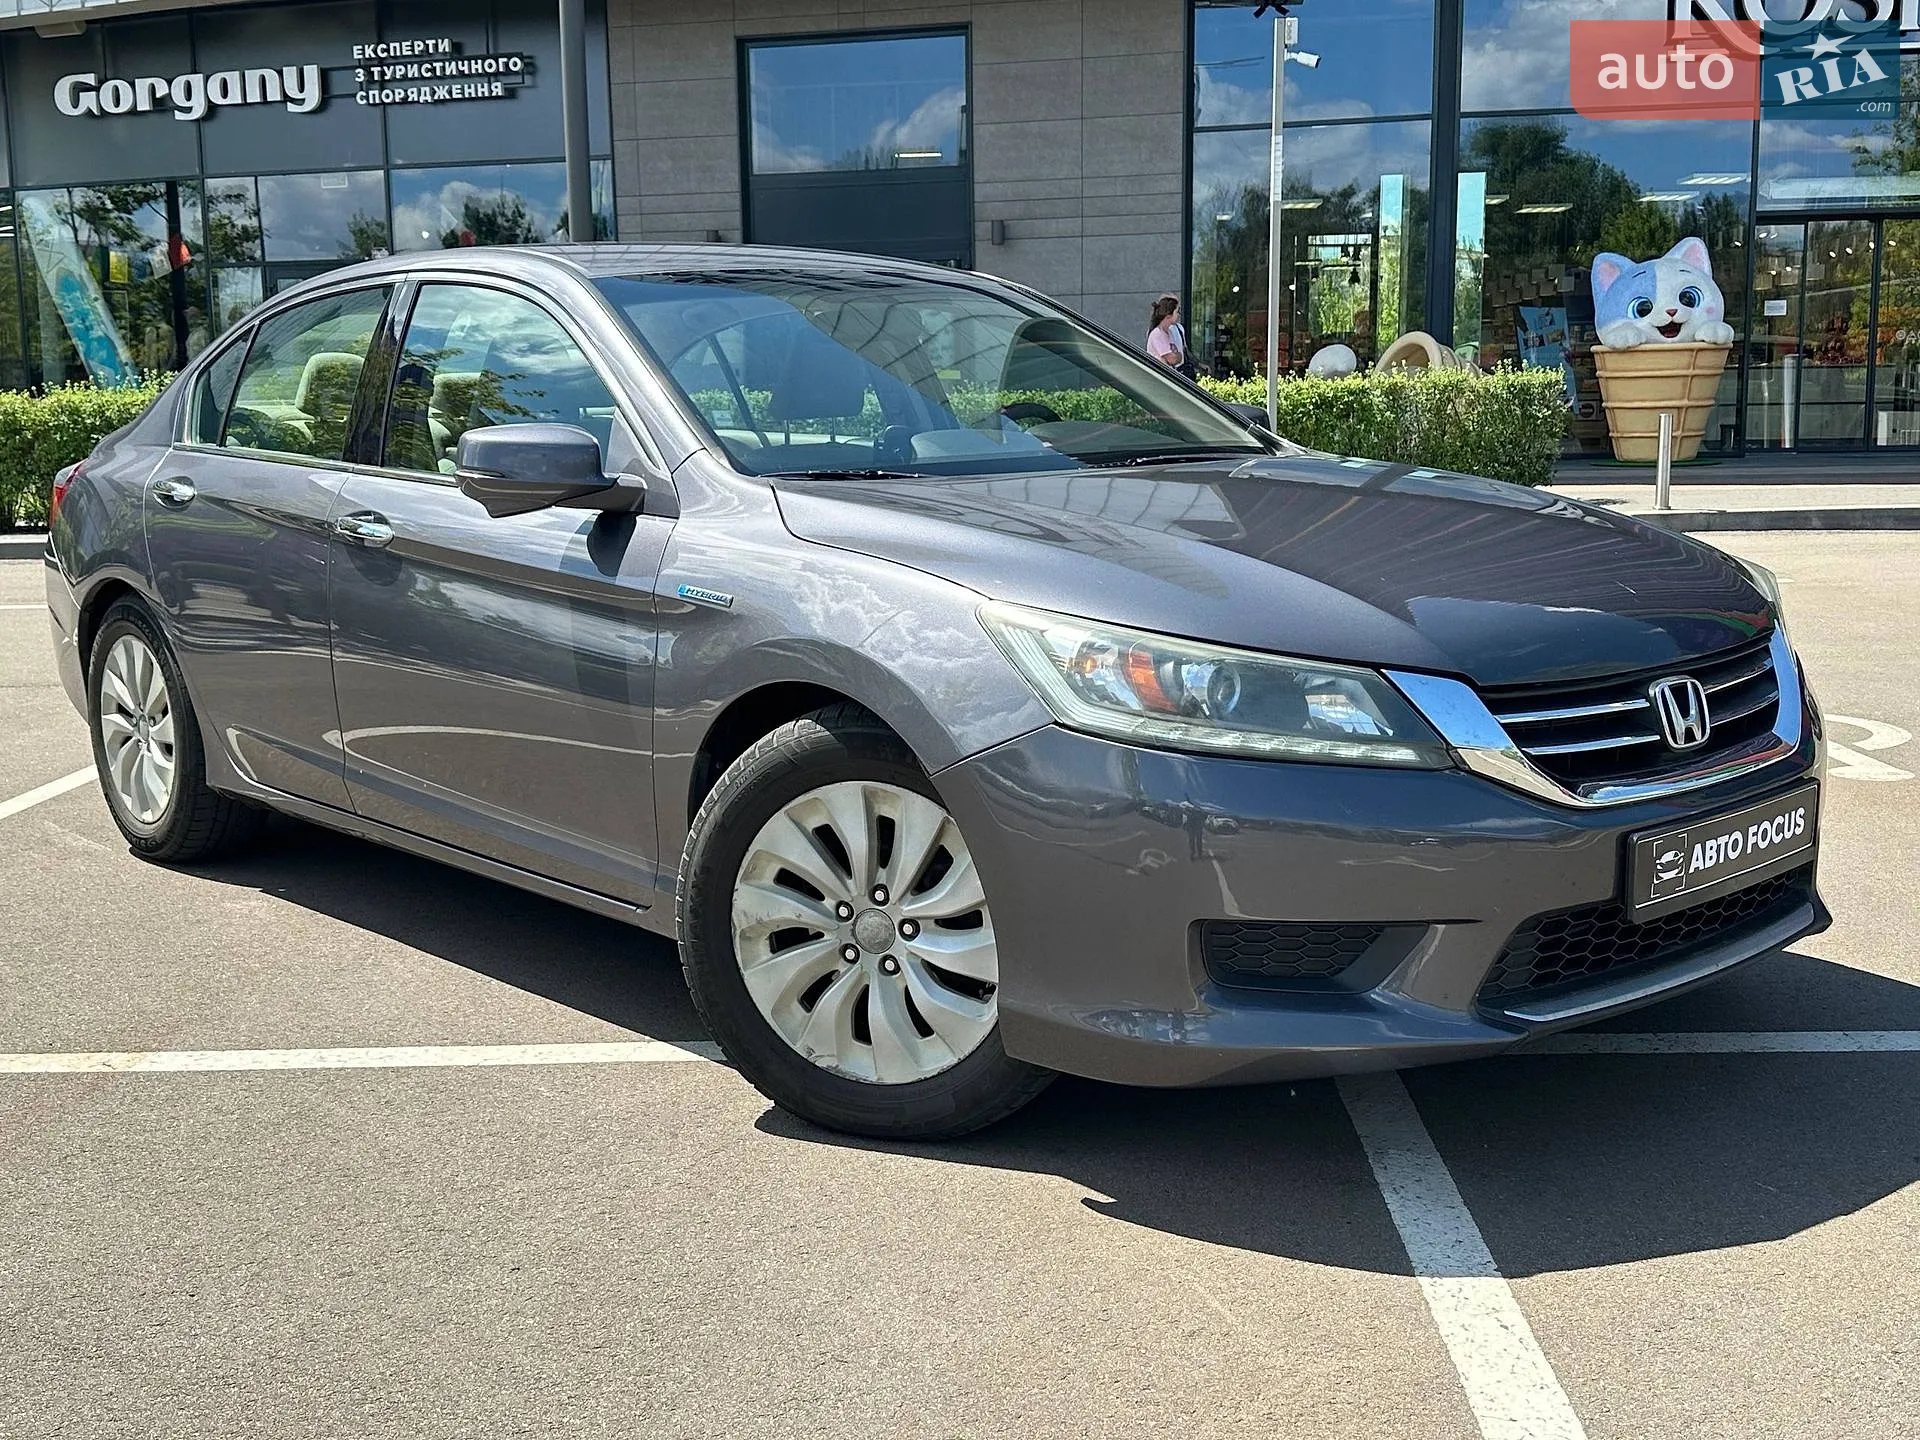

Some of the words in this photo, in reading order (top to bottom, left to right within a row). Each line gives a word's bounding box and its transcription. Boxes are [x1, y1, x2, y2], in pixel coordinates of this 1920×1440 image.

[352, 38, 451, 60] ЕКСПЕРТИ
[370, 56, 523, 82] ТУРИСТИЧНОГО
[53, 64, 321, 121] Gorgany
[355, 81, 503, 105] СПОРЯДЖЕННЯ
[685, 586, 729, 602] HYBRID
[1746, 807, 1806, 855] FOCUS
